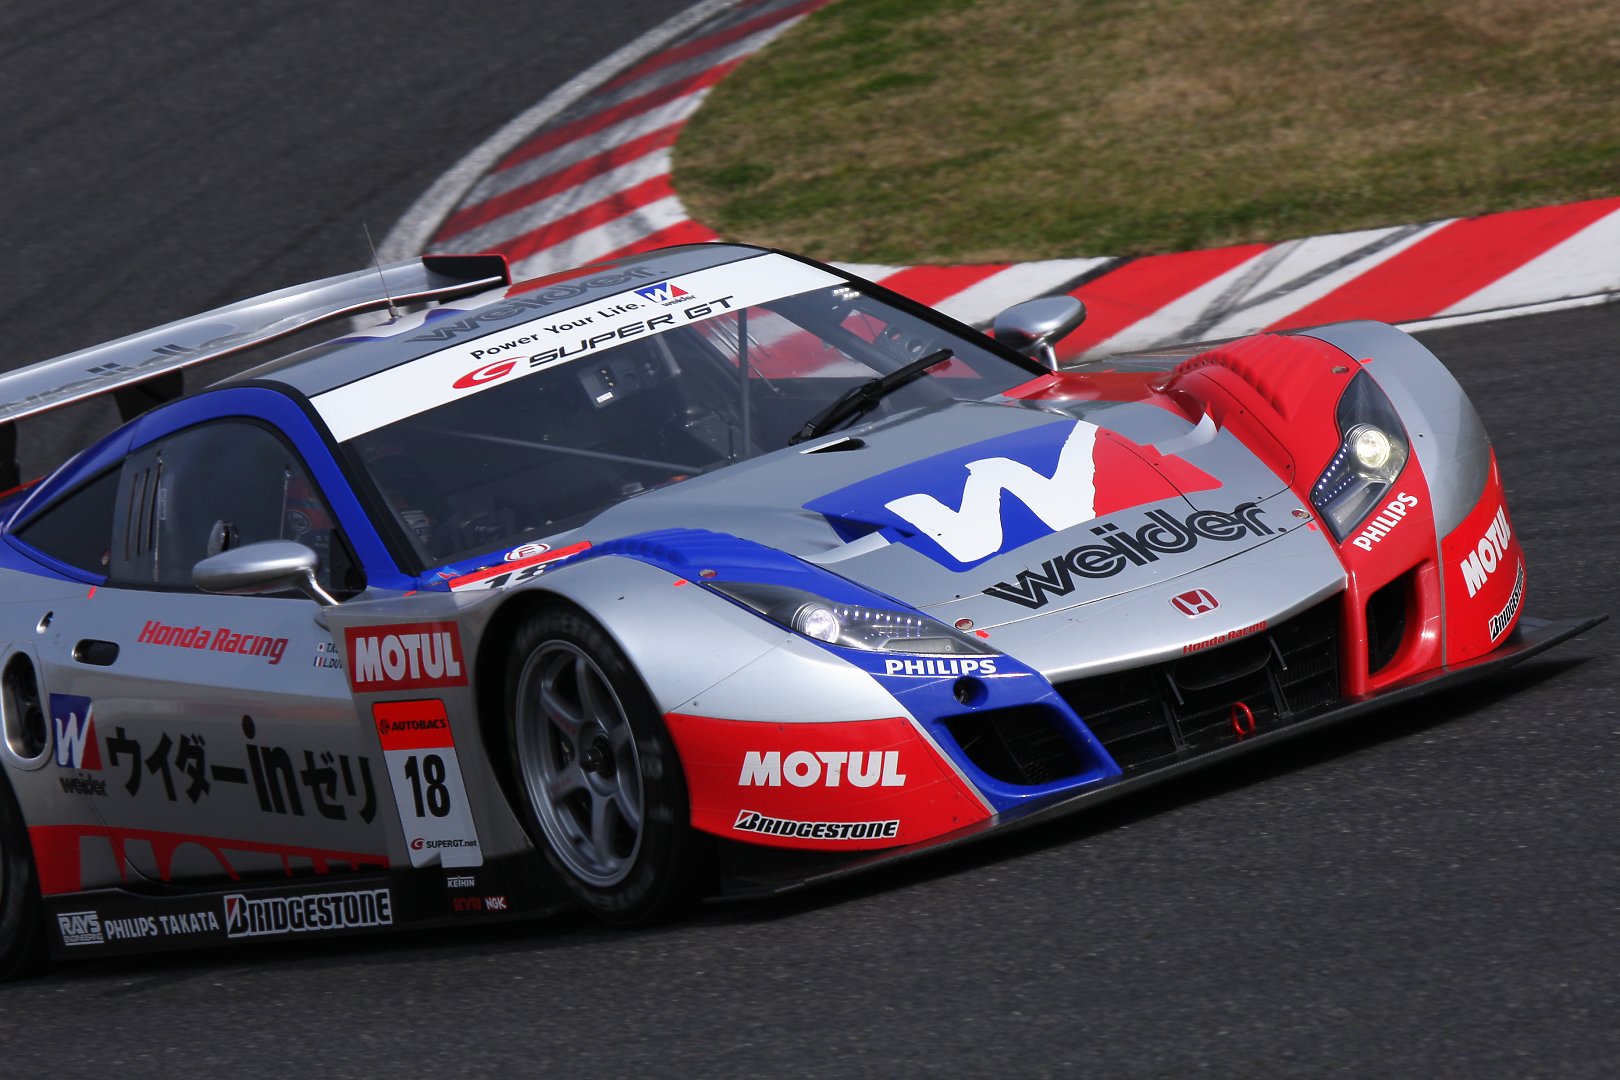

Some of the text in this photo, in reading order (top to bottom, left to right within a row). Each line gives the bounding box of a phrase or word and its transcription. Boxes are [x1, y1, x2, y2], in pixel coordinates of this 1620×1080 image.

[470, 302, 646, 360] Power Your Life.
[530, 313, 676, 367] SUPER
[684, 295, 733, 320] GT
[1352, 492, 1418, 552] PHILIPS
[1460, 505, 1511, 598] MOTUL
[137, 620, 289, 665] Honda Racing
[1183, 620, 1267, 654] Honda Racing
[356, 632, 460, 682] MOTUL
[885, 659, 997, 675] PHILIPS
[391, 718, 447, 731] AUTOBACS
[404, 754, 451, 818] 18
[738, 750, 906, 787] MOTUL
[733, 809, 900, 840] BRIDGESTONE
[426, 839, 477, 849] SUPERGT.net
[447, 879, 475, 888] KEIHIN
[223, 889, 393, 938] BRIDGESTONE
[485, 896, 507, 910] NGK
[58, 914, 100, 936] RAYS
[104, 911, 219, 940] PHILIPS TAKATA
